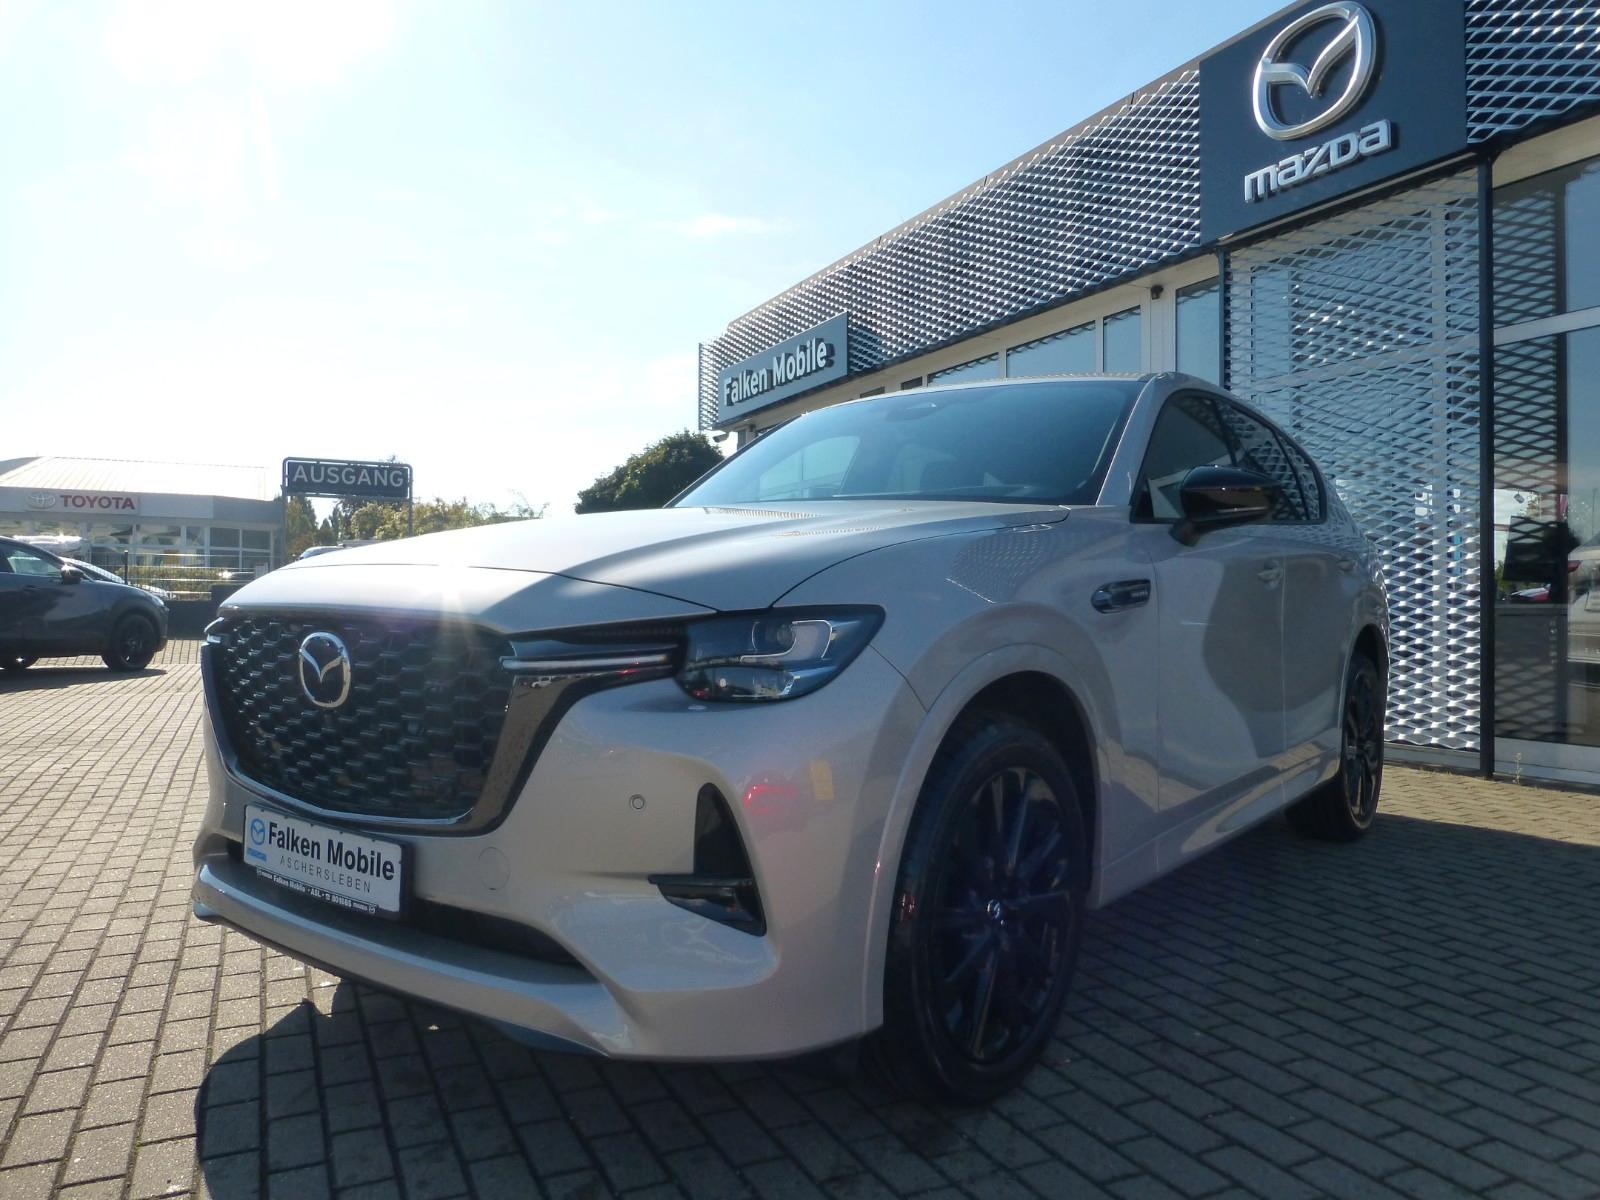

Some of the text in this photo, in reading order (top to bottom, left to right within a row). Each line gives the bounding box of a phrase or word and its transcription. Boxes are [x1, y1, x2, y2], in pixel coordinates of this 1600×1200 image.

[724, 337, 827, 406] Falken Mobile
[293, 465, 404, 487] AUSGANG
[60, 494, 136, 510] TOYOTA
[268, 821, 395, 881] Falken Mobile
[280, 855, 371, 893] ASCHERSLEBEN
